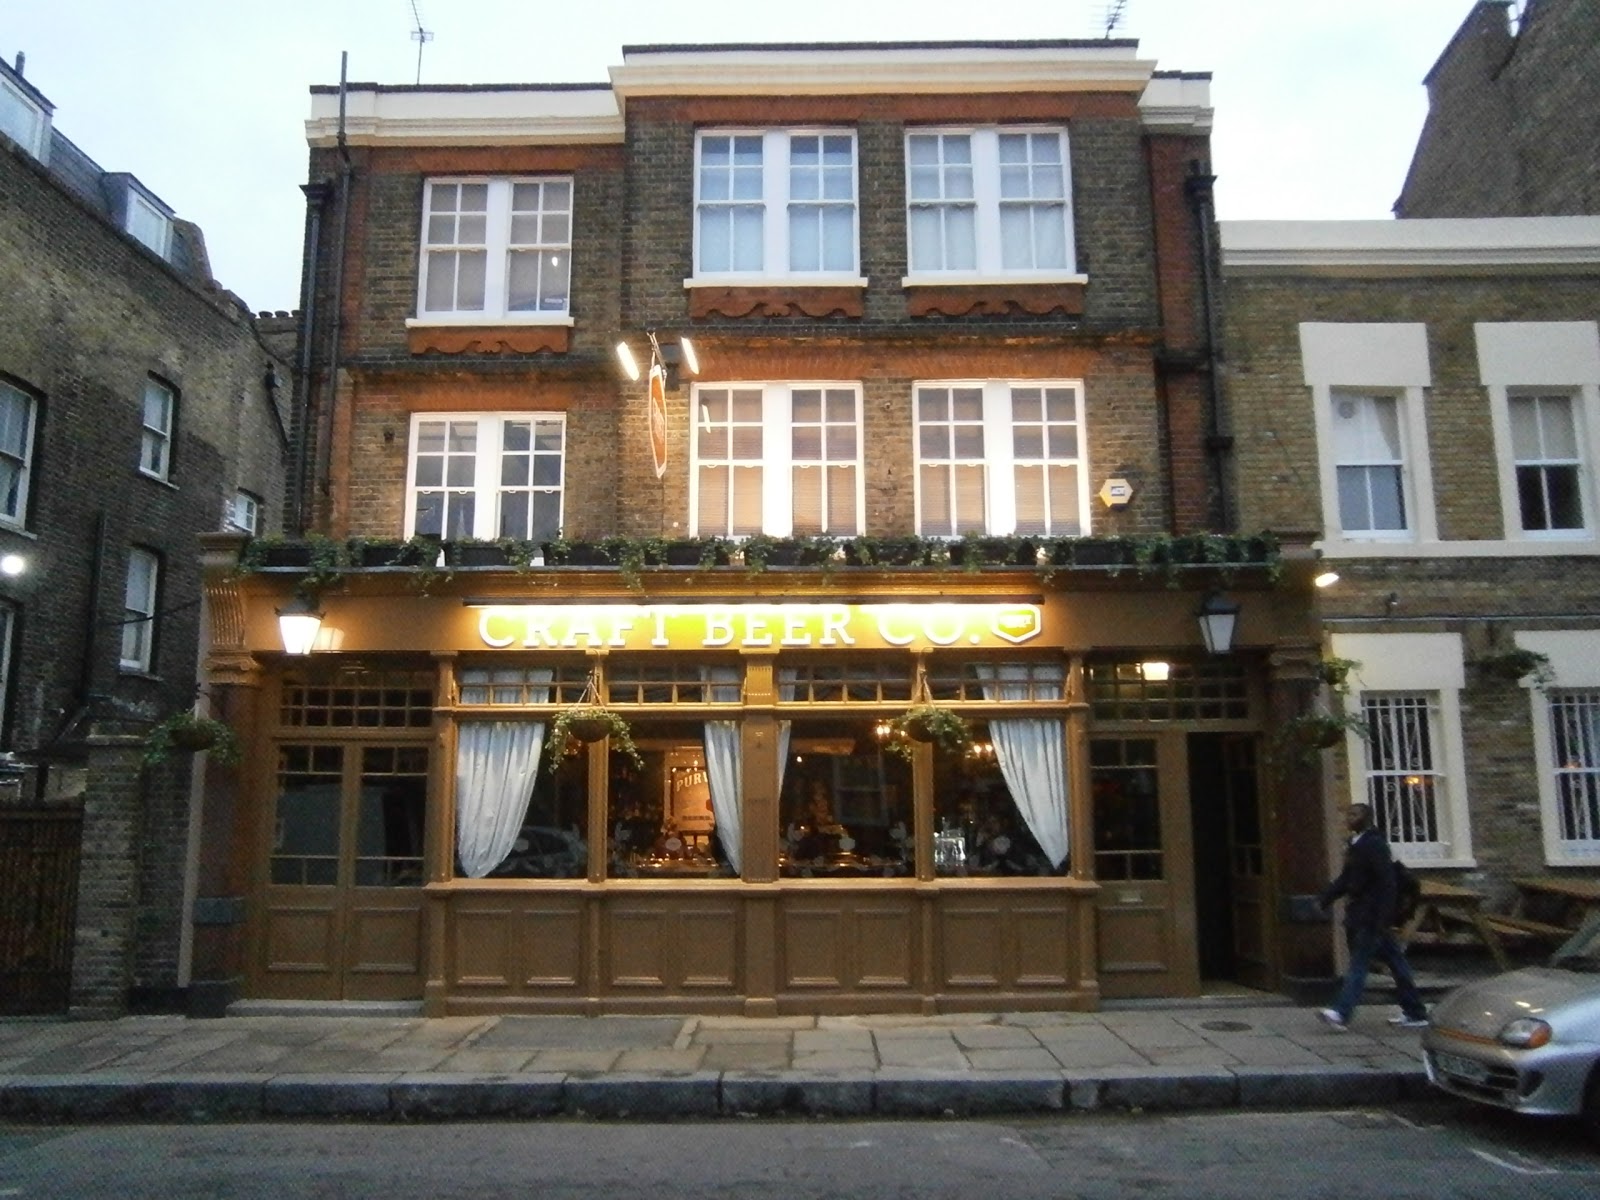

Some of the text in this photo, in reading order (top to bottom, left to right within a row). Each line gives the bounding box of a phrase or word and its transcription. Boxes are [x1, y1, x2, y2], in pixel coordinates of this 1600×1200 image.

[478, 604, 981, 647] CRAFT BEER CO.
